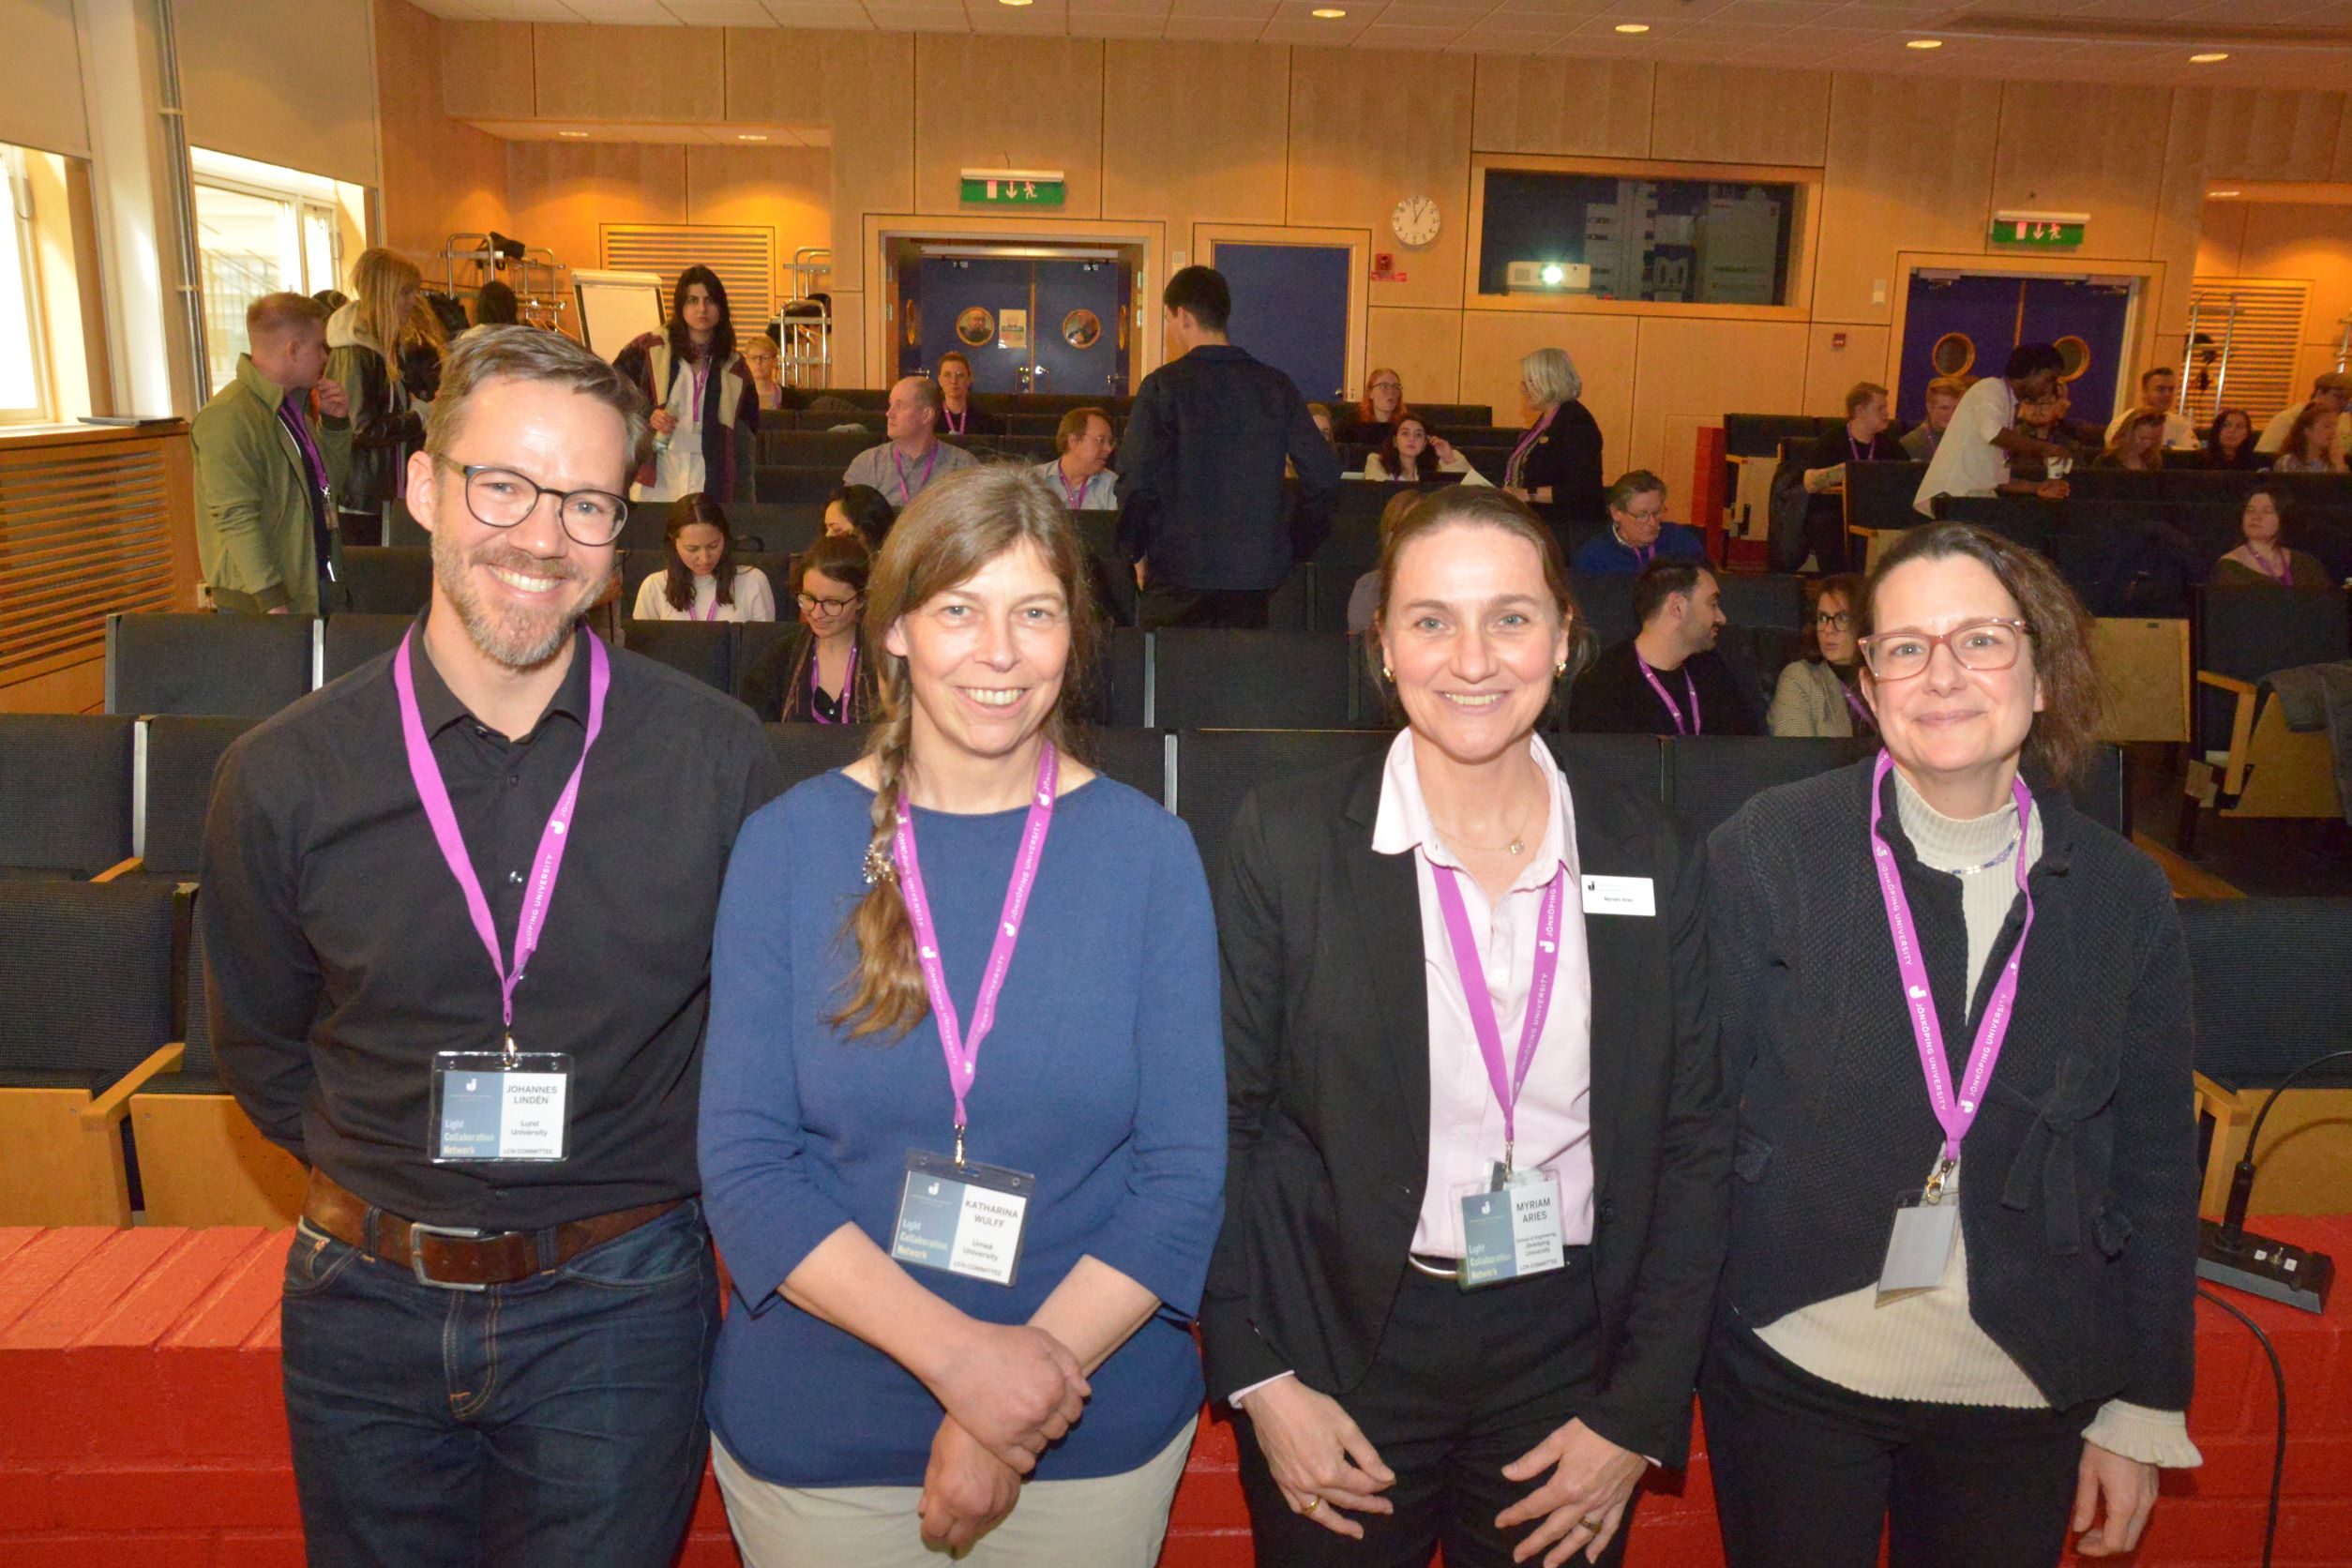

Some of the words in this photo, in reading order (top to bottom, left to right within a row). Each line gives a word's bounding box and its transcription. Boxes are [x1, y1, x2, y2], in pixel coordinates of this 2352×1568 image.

[1025, 822, 1040, 868] UNIVERSITY
[534, 853, 552, 906] UNIVERSITY
[908, 877, 923, 926] UNIVERSITY
[1895, 914, 1911, 965] UNIVERSITY
[1533, 972, 1548, 1024] UNIVERSITY
[1969, 1046, 1989, 1096] JÖNKÖPING
[1985, 993, 2007, 1044] UNIVERSITY
[1916, 1002, 1933, 1053] JÖNKÖPING
[1929, 1057, 1945, 1110] UNIVERSITY
[506, 1085, 558, 1093] JOHANNES
[514, 1095, 549, 1104] LINDÉN
[510, 1128, 547, 1138] University
[965, 1200, 1018, 1218] KATHARINA
[1516, 1197, 1551, 1212] MYRIAM
[974, 1214, 1005, 1229] WULFF
[1523, 1211, 1548, 1223] ARIES
[962, 1247, 999, 1262] University
